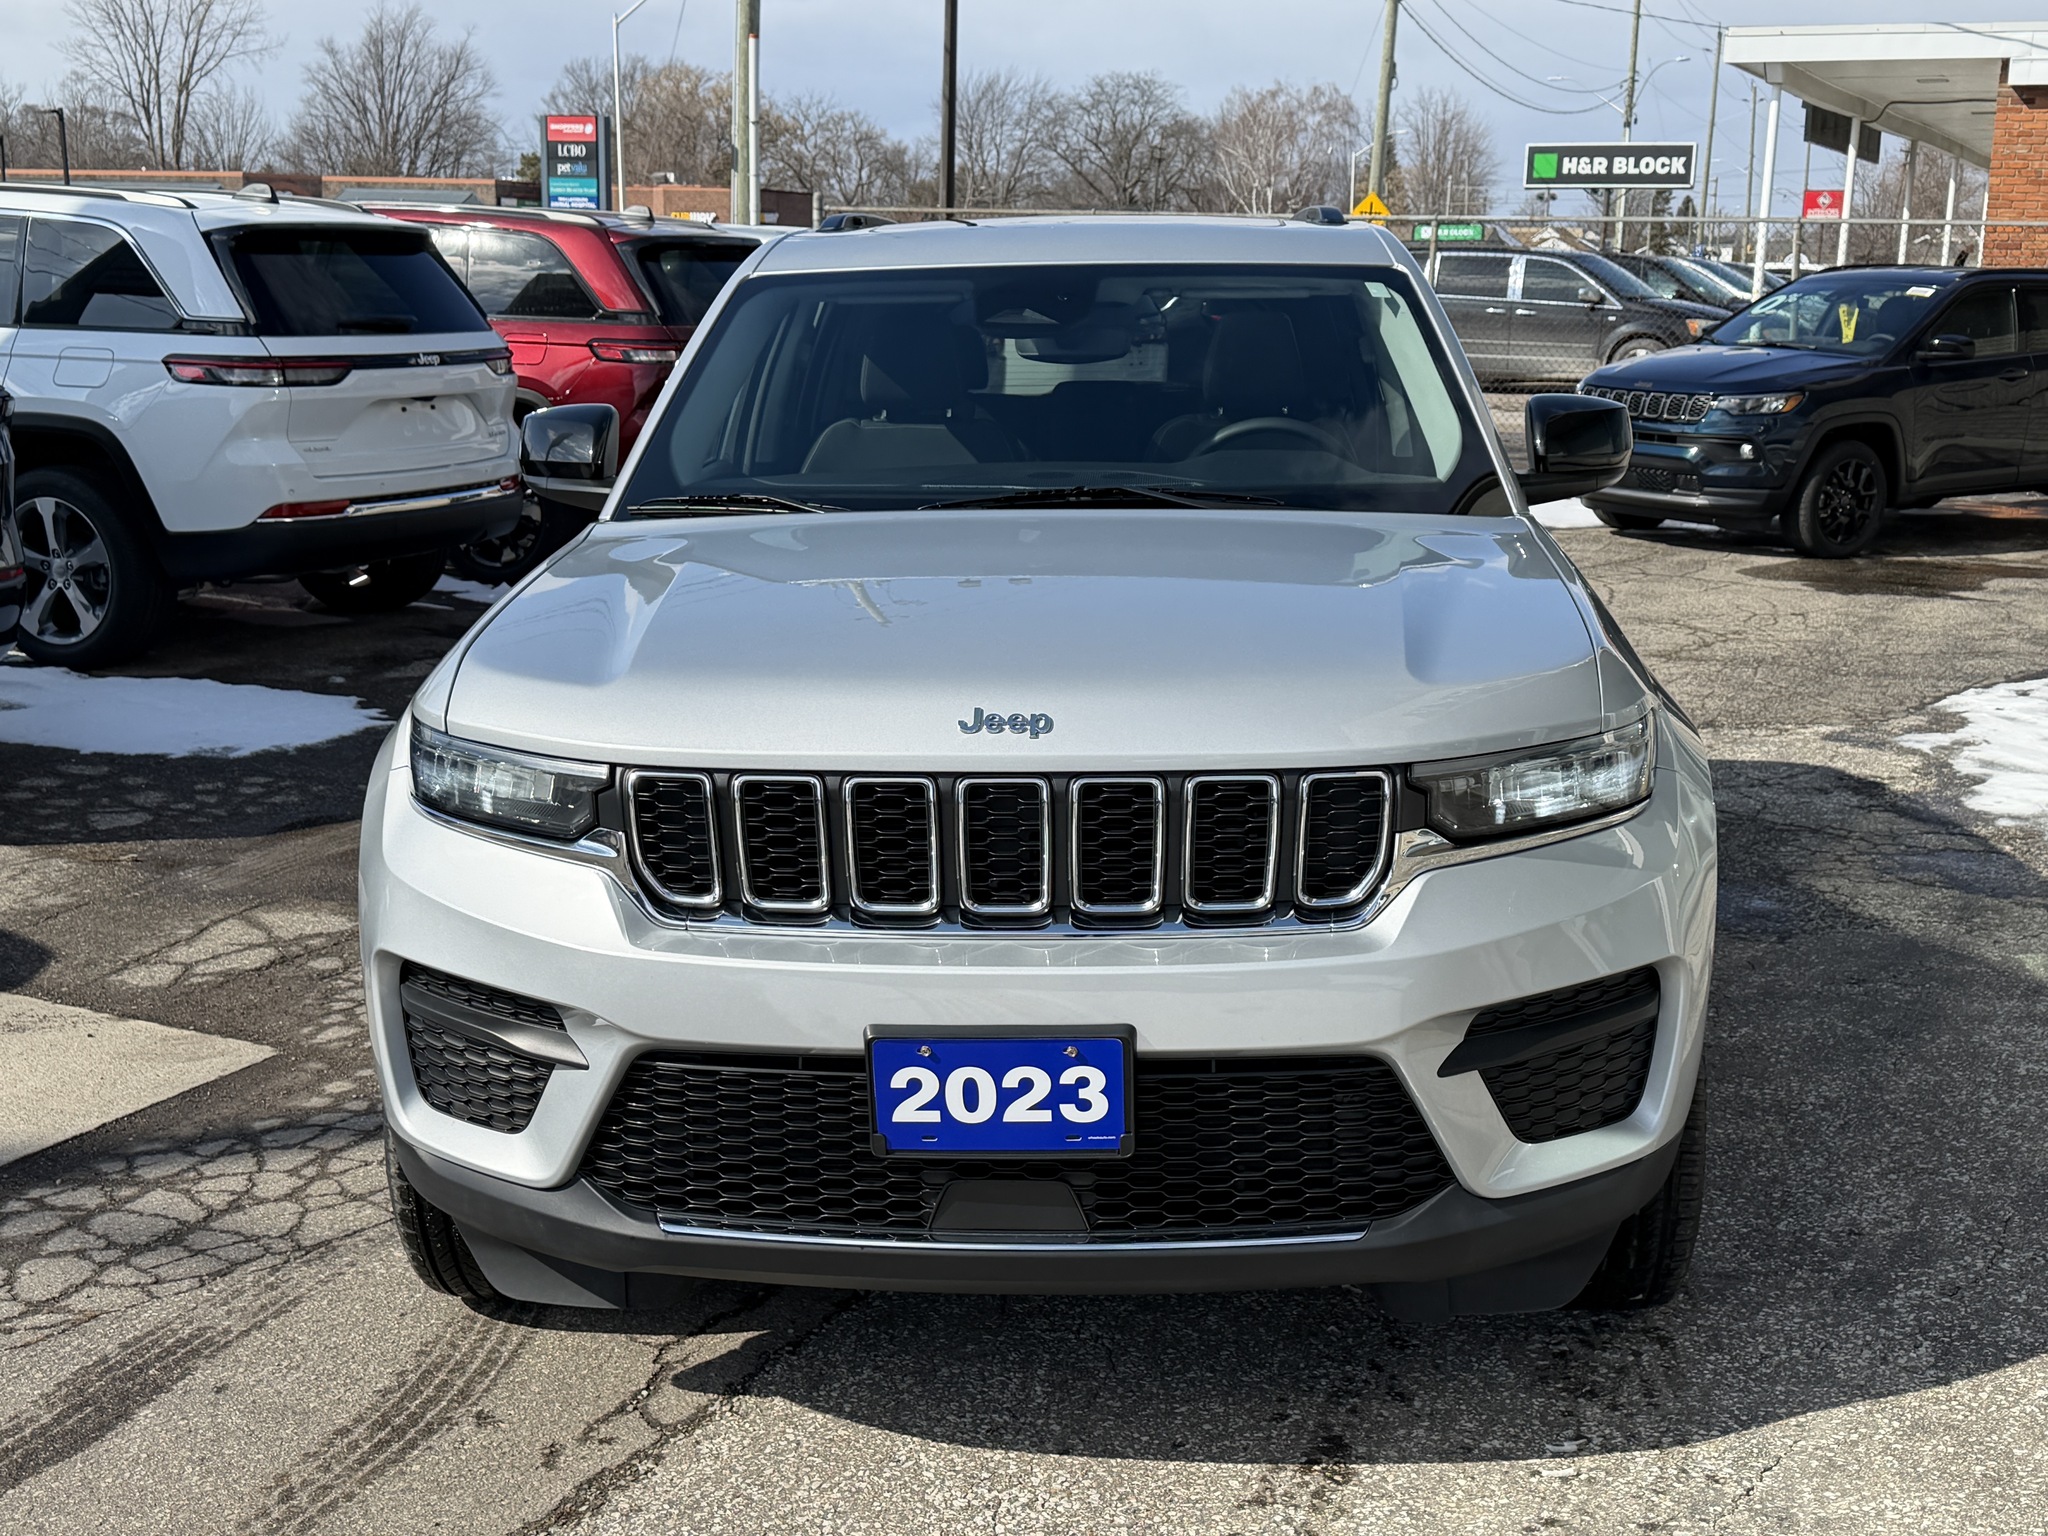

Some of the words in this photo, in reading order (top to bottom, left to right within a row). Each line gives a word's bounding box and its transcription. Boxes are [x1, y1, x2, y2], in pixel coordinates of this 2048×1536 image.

[557, 143, 587, 157] LCBO
[1562, 156, 1609, 175] H&R
[1612, 156, 1687, 175] BLOCK
[417, 352, 440, 366] Jeep
[957, 706, 1054, 739] Jeep
[890, 1066, 1109, 1124] 2023
